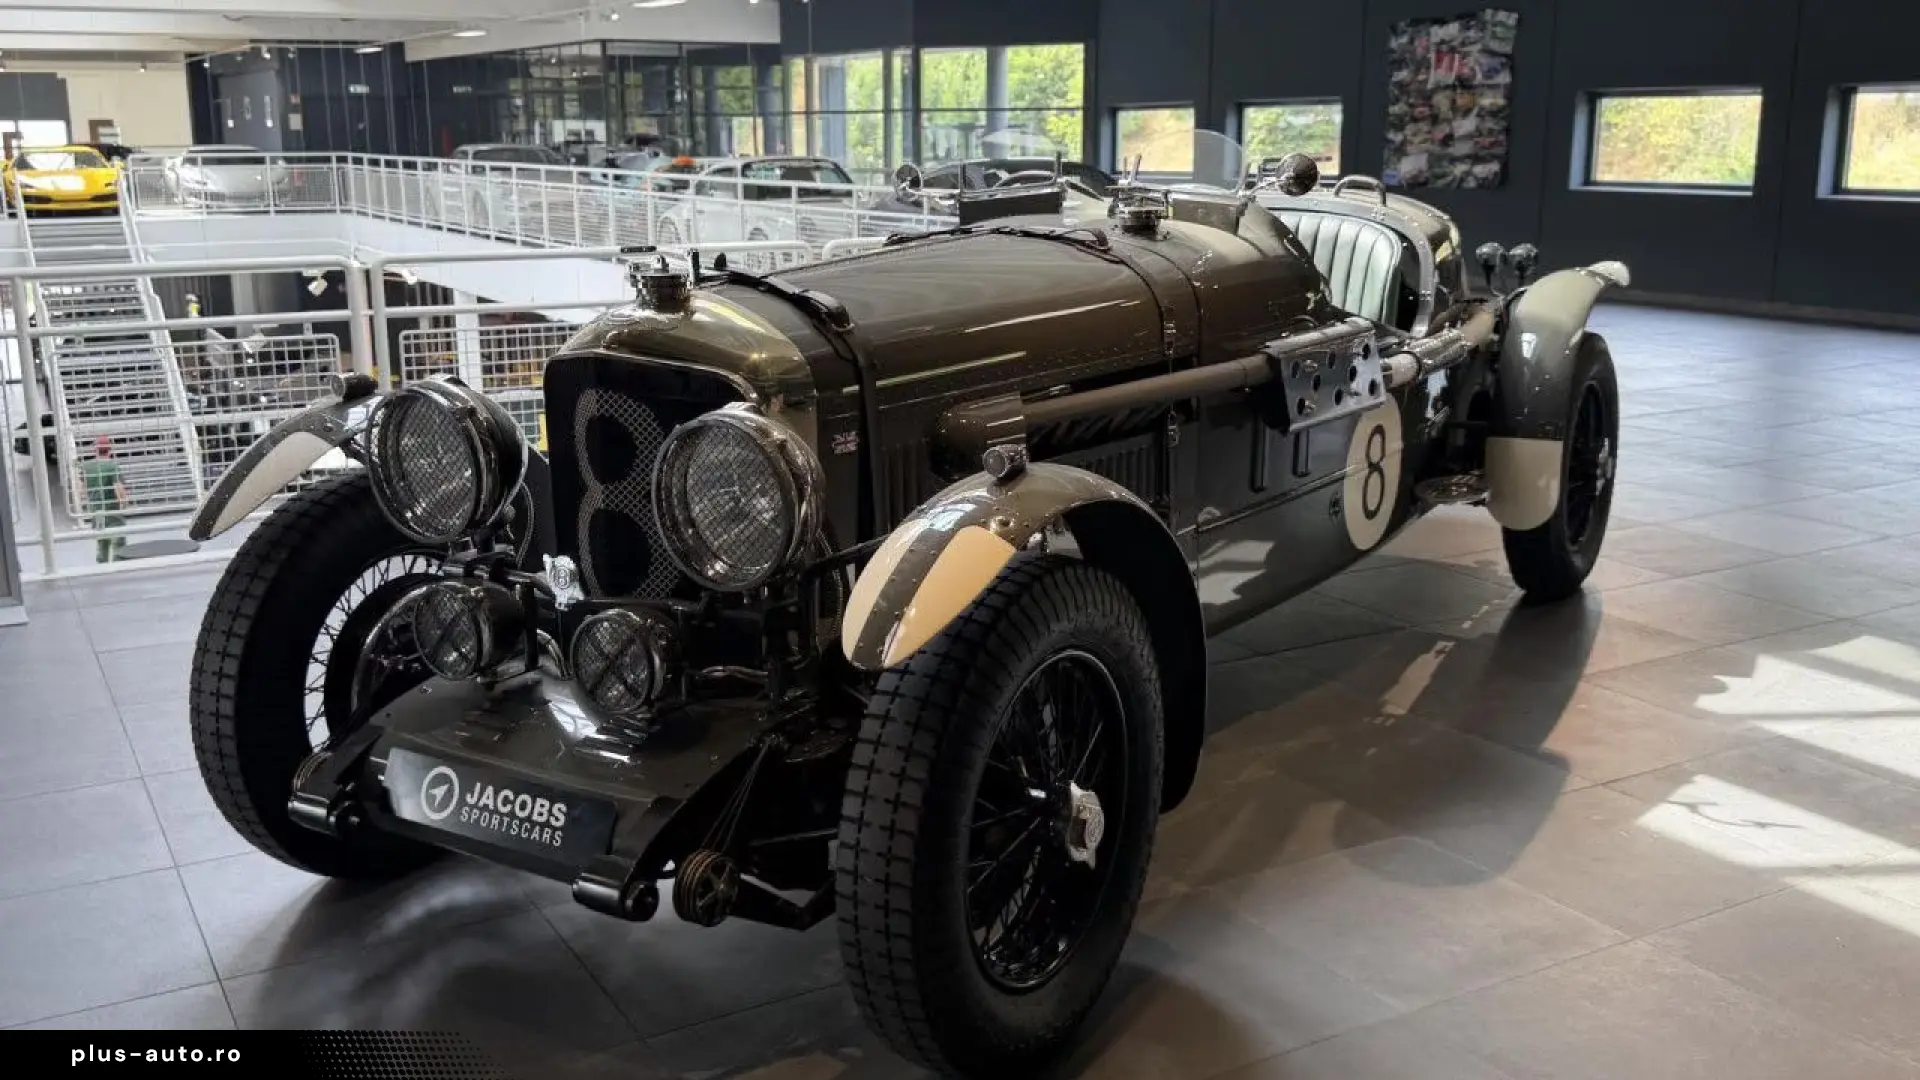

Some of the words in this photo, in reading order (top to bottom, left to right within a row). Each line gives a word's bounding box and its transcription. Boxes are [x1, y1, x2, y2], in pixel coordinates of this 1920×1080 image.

[1362, 423, 1386, 521] 8
[459, 806, 563, 847] SPORTSCARS
[465, 782, 568, 827] JACOBS
